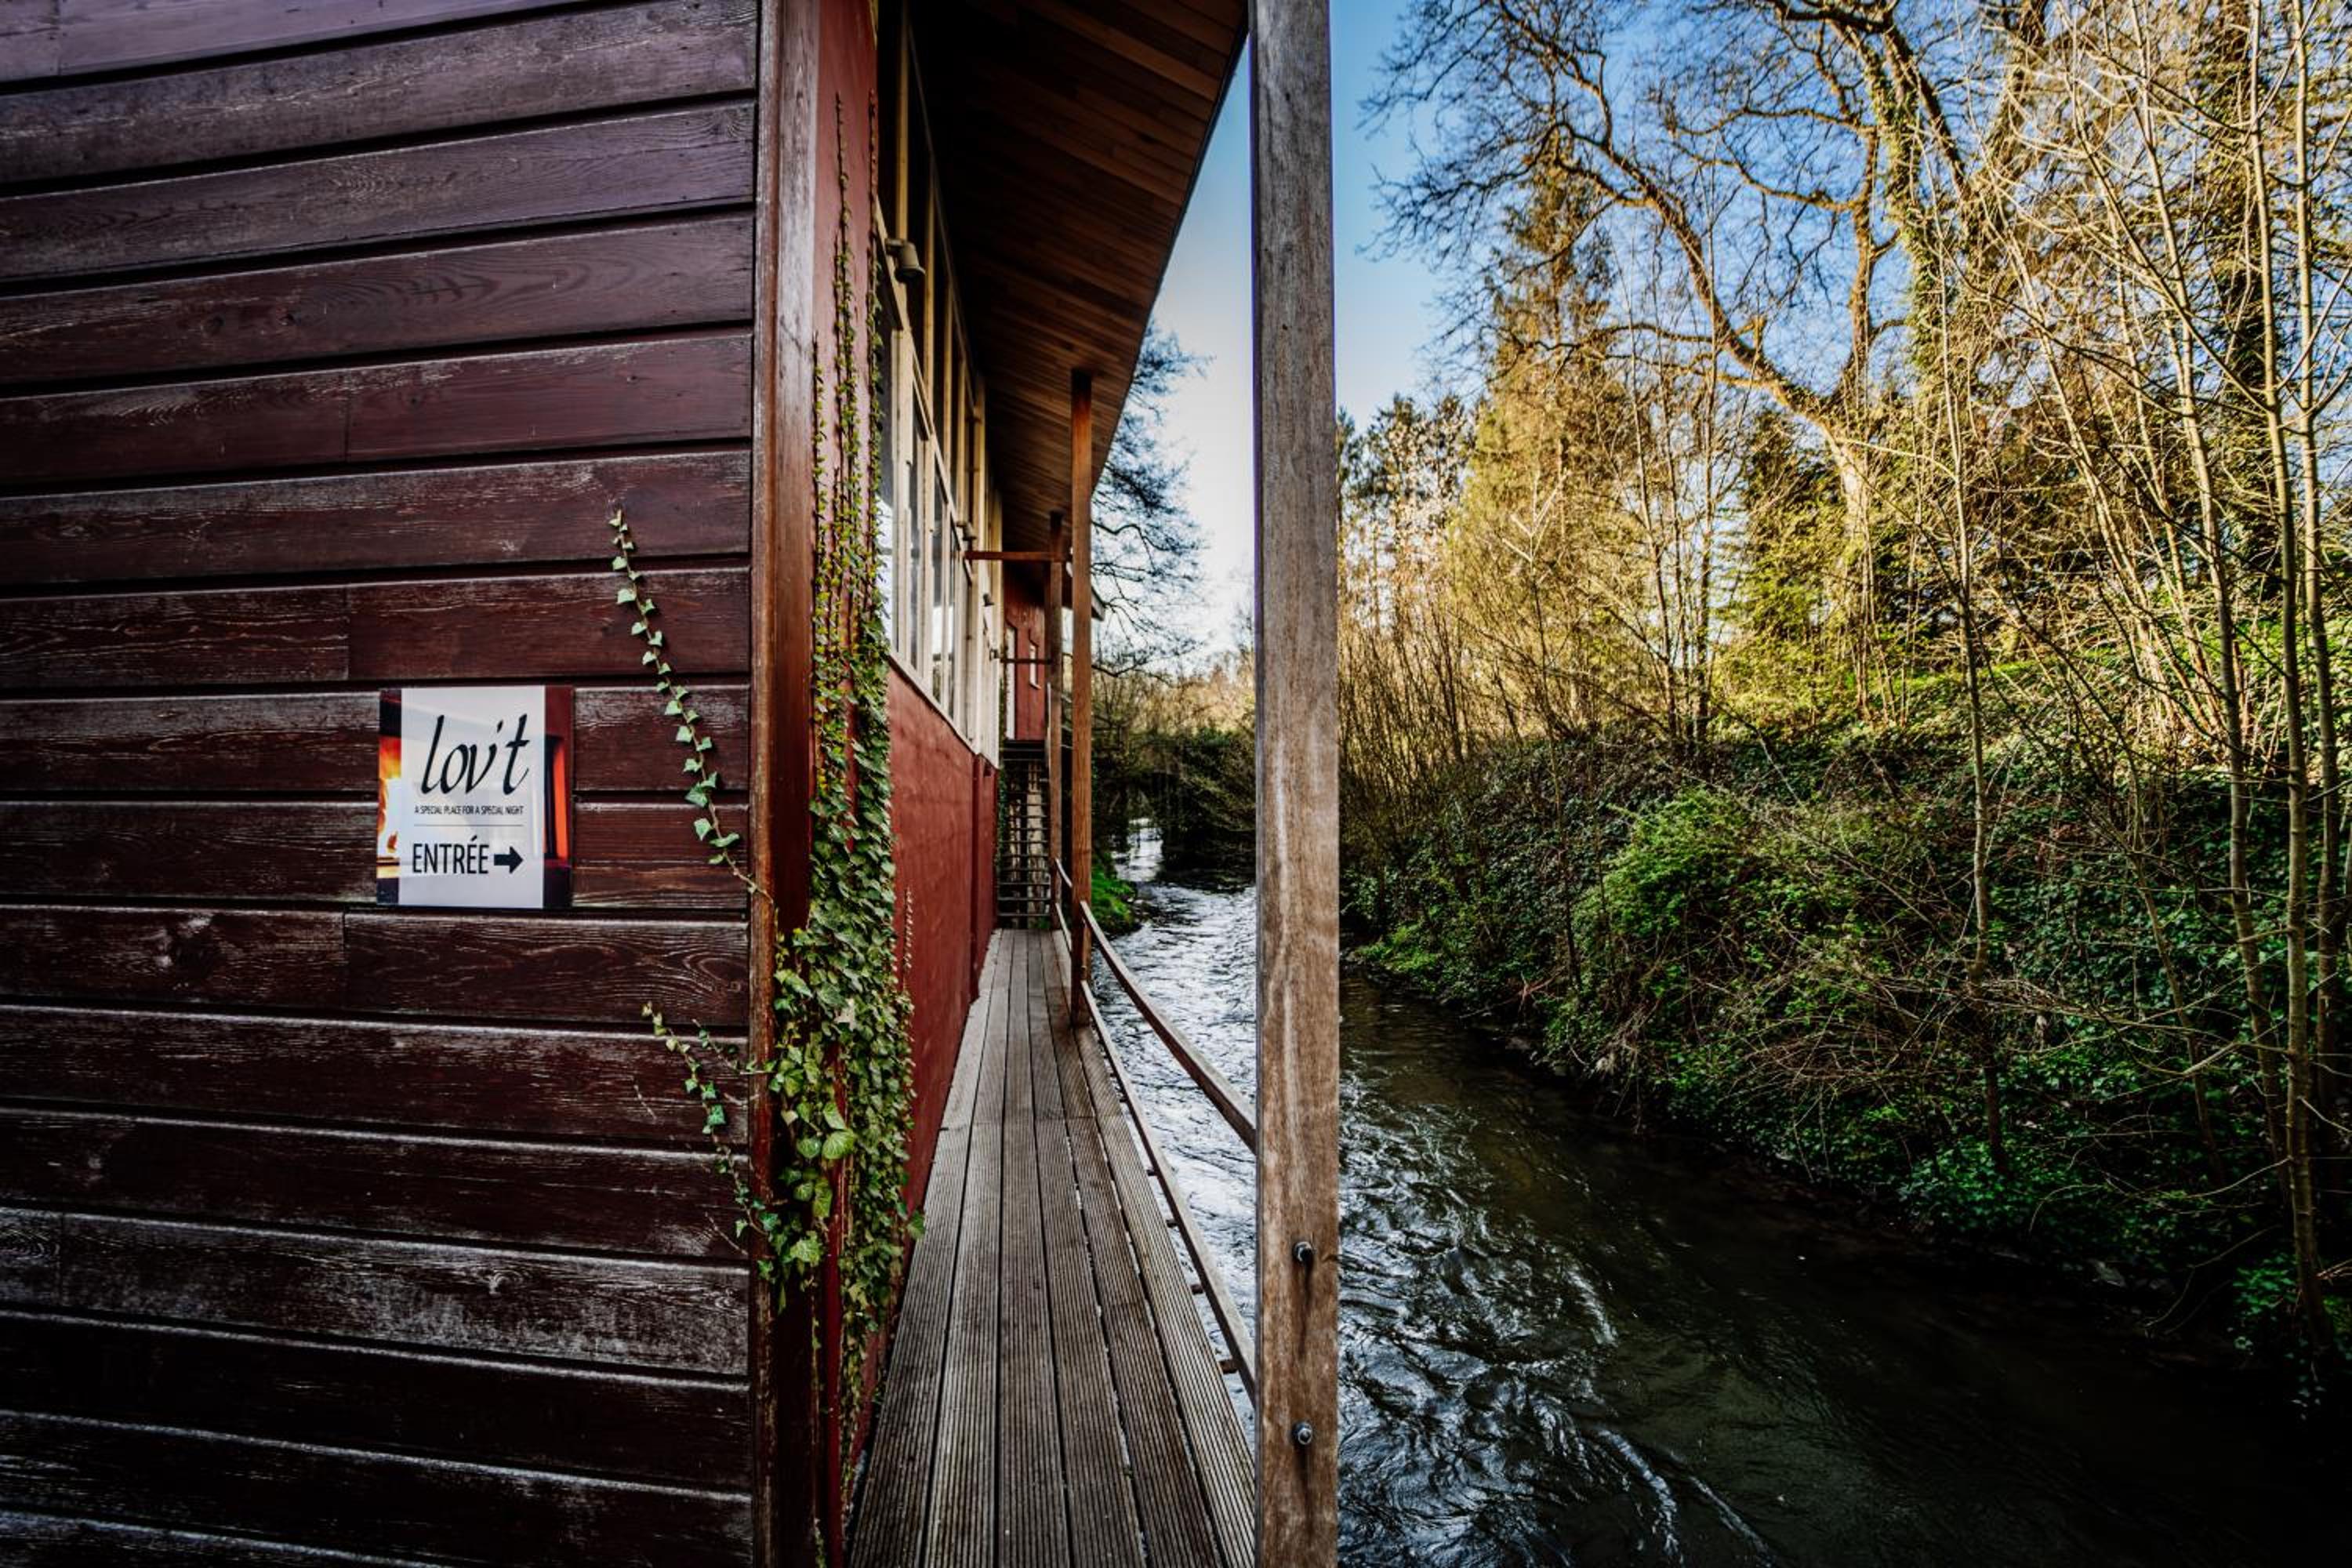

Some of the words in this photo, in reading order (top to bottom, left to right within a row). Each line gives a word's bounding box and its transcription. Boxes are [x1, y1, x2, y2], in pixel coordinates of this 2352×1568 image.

[415, 805, 419, 815] A
[420, 805, 443, 815] SPECIAL
[444, 805, 462, 815] PLACE
[463, 805, 474, 815] FOR
[476, 805, 481, 815] A
[481, 805, 504, 815] SPECIAL
[505, 805, 524, 815] NIGHT
[412, 835, 490, 874] ENTRÉE
